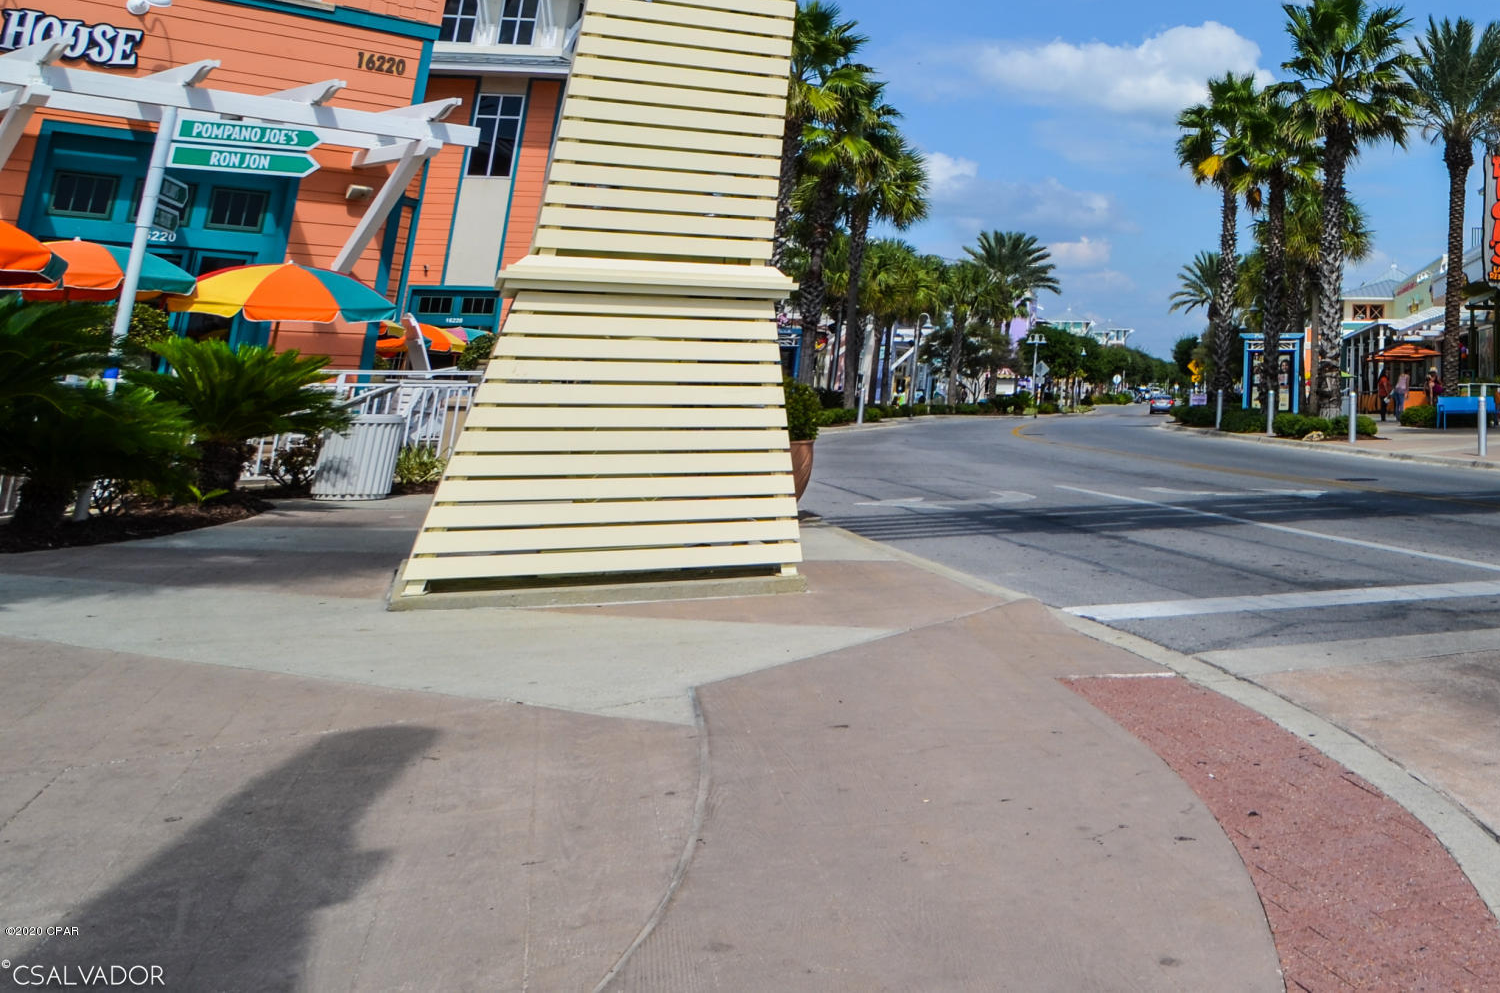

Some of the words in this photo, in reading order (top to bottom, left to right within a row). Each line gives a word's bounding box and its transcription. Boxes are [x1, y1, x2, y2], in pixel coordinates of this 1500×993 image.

[1, 8, 144, 67] HOUSE
[356, 51, 406, 76] 16220
[192, 122, 261, 142] POMPANO
[262, 127, 299, 145] JOE'S
[209, 151, 242, 168] RON
[242, 154, 271, 170] JON
